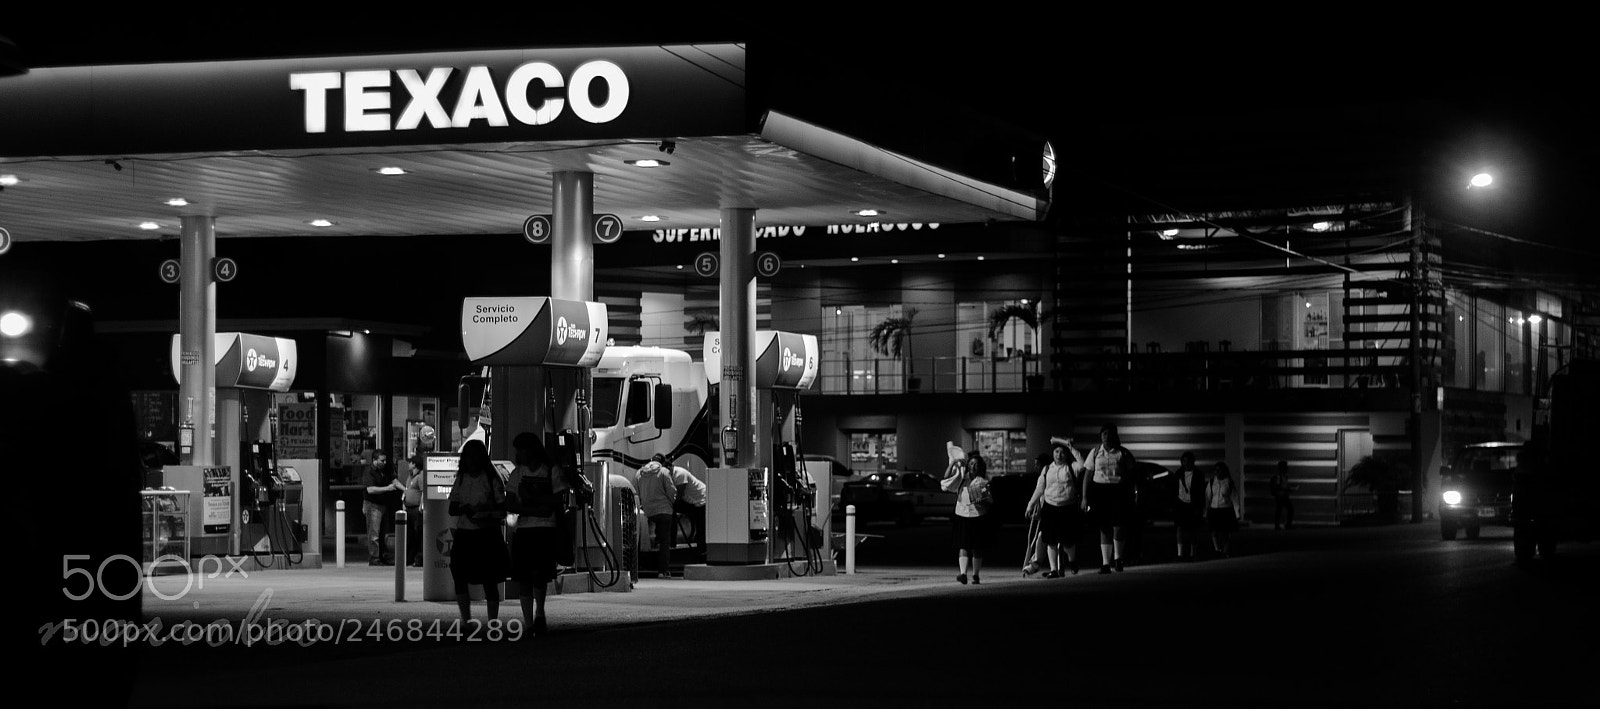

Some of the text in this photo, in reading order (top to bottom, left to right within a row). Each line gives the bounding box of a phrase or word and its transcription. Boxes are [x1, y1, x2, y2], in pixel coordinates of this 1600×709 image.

[290, 60, 630, 133] TEXACO
[532, 221, 544, 237] 8
[602, 220, 614, 237] 7
[220, 263, 230, 277] 4
[702, 257, 712, 272] 5
[763, 257, 774, 271] 6
[166, 265, 176, 278] 3
[476, 304, 515, 313] Servicio
[472, 314, 518, 324] Completo
[595, 328, 601, 343] 7
[283, 358, 289, 372] 4
[280, 422, 314, 436] Mart
